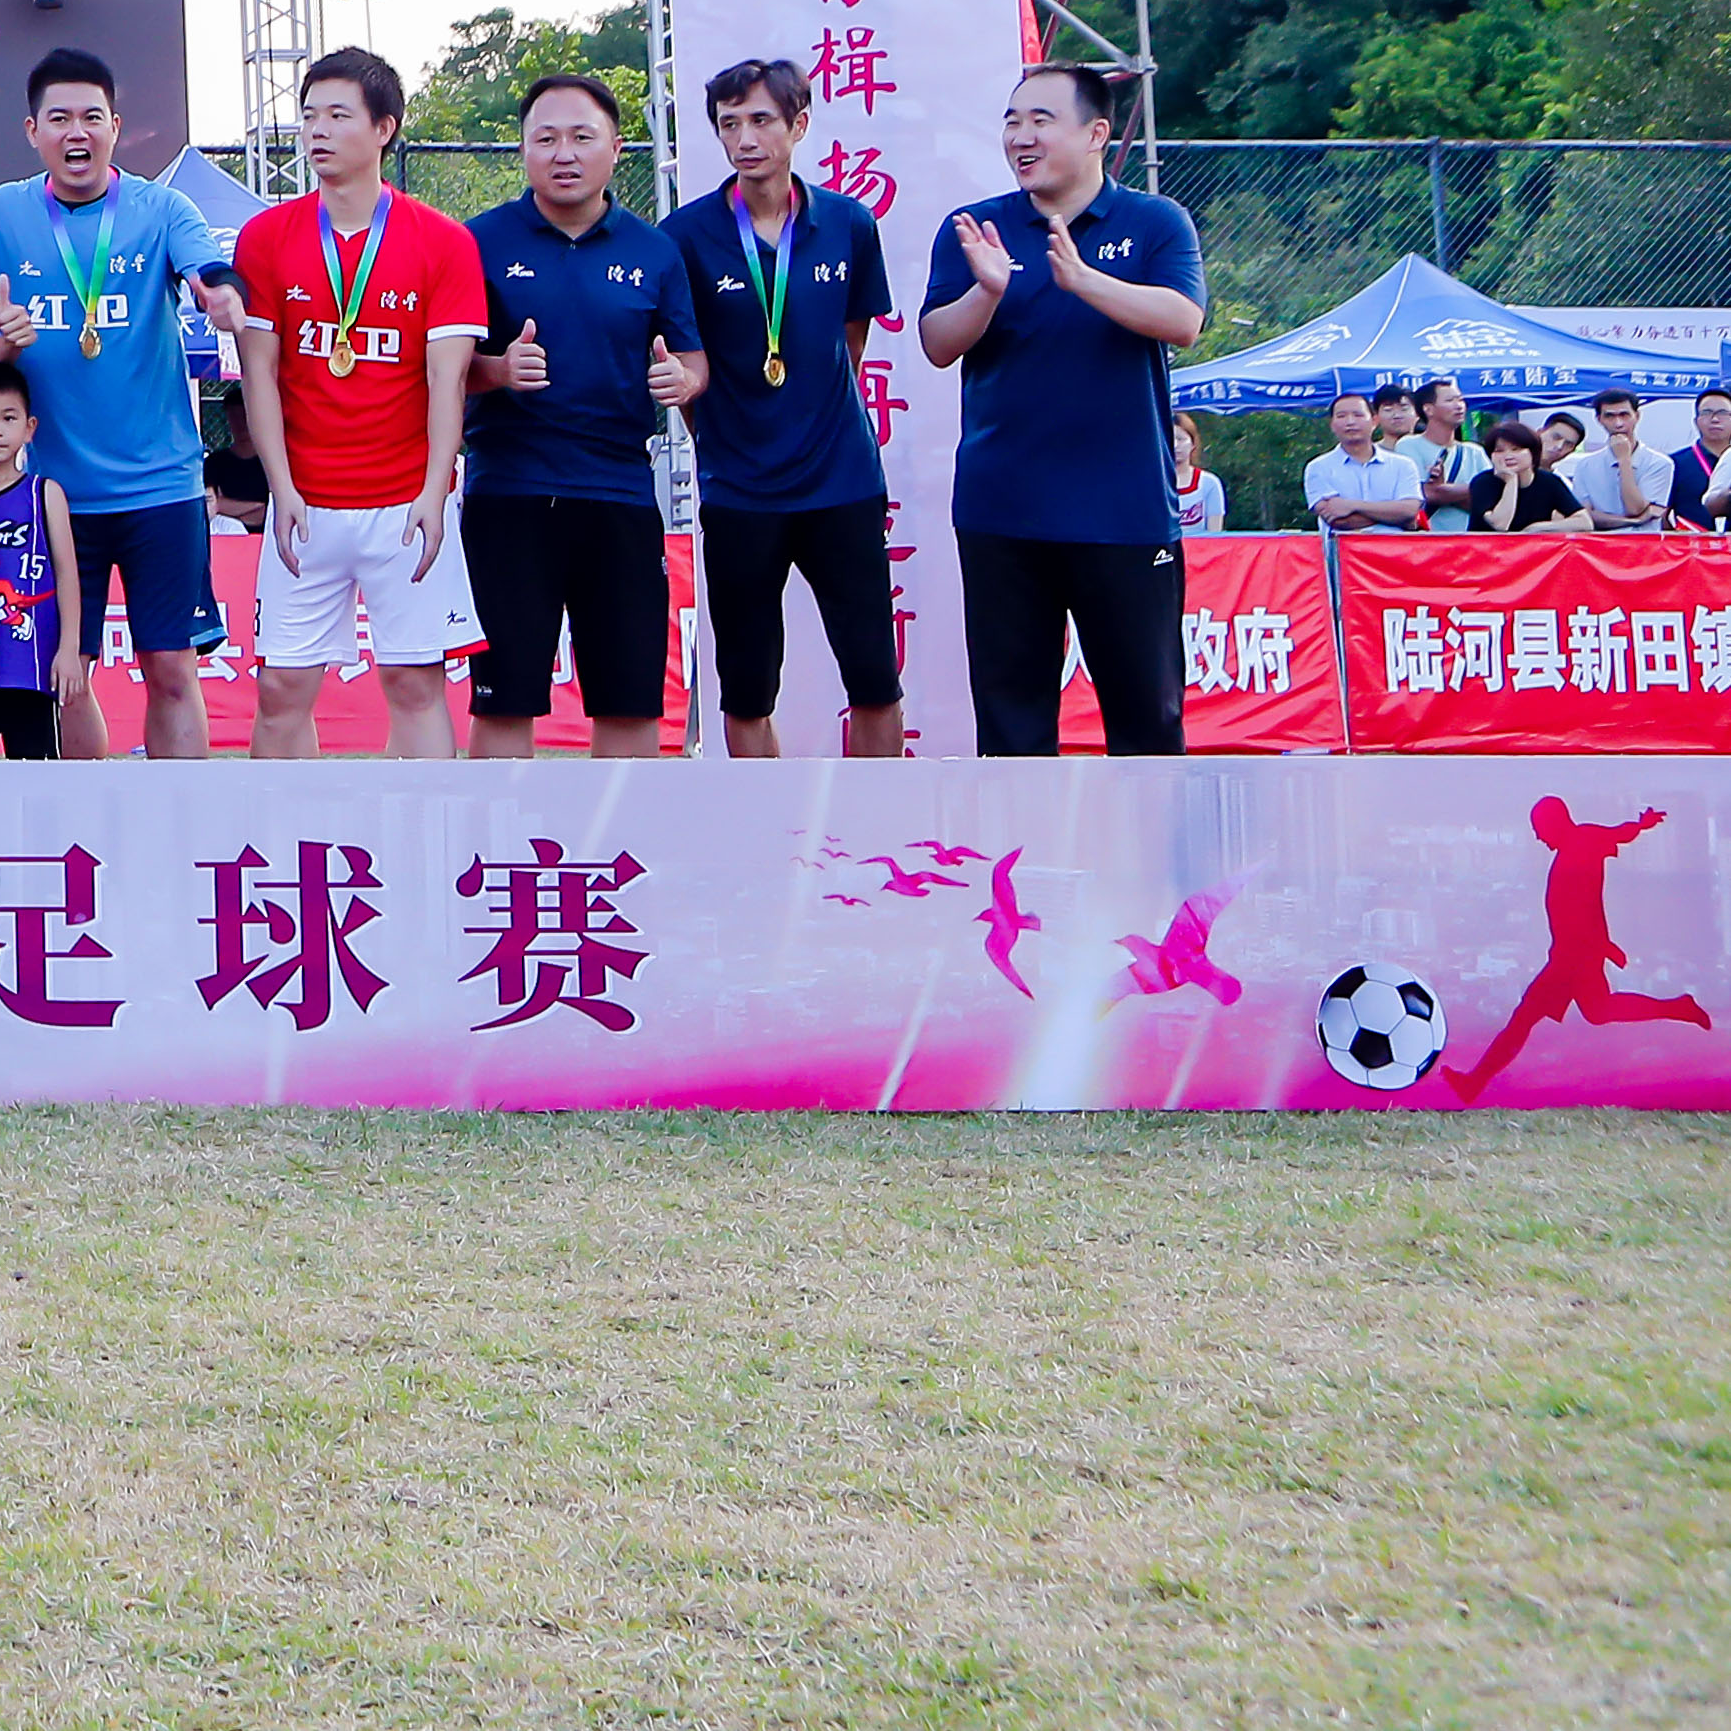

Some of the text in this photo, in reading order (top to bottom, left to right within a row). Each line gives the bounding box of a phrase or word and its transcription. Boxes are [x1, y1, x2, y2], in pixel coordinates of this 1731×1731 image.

[28, 294, 130, 331] 红卫
[298, 320, 401, 363] 红卫
[19, 553, 46, 580] 15
